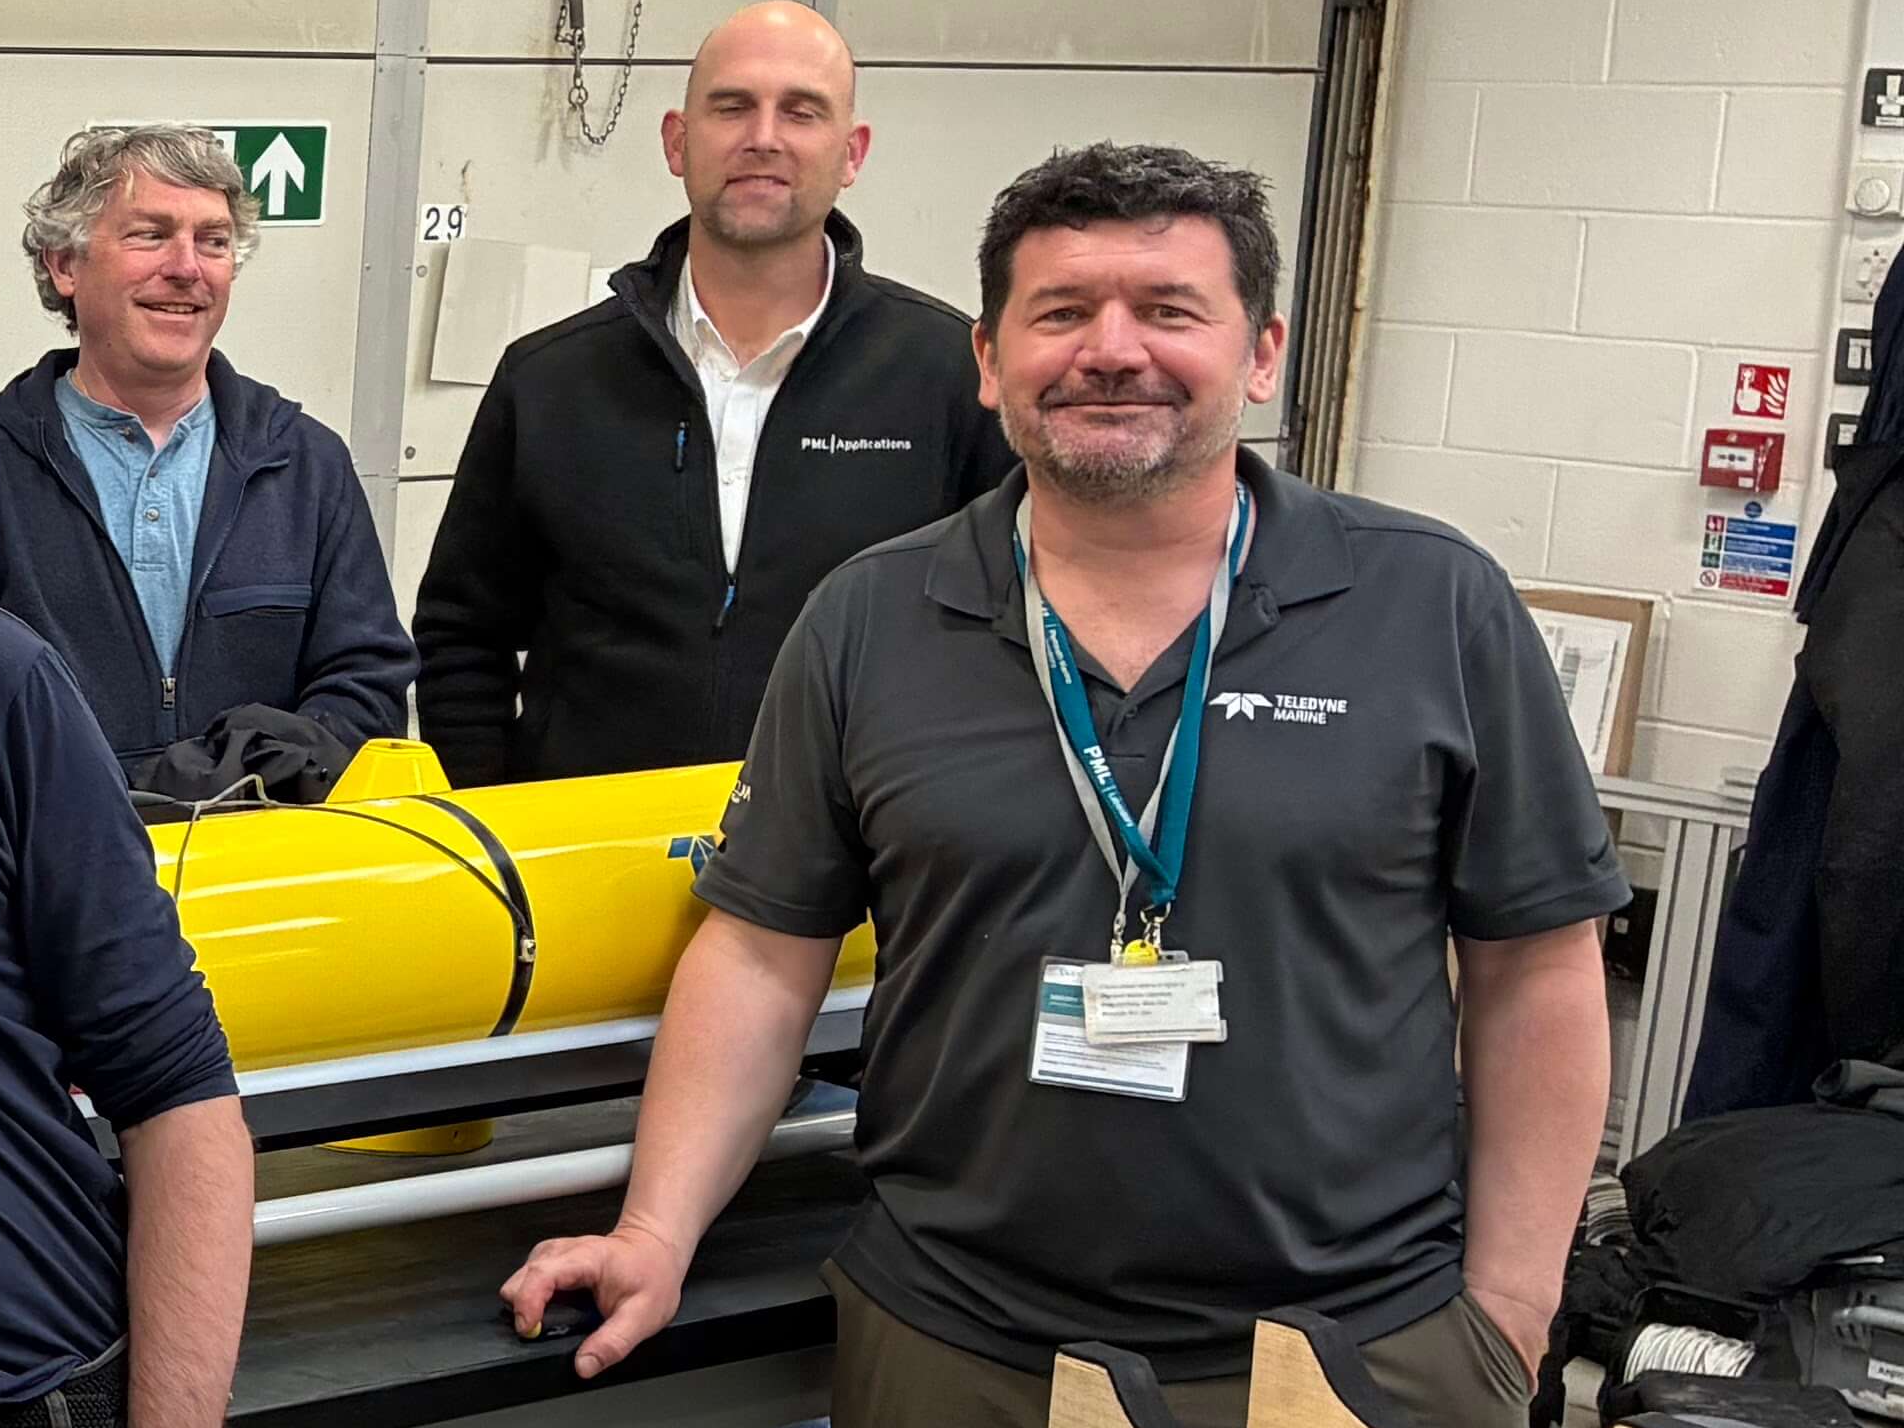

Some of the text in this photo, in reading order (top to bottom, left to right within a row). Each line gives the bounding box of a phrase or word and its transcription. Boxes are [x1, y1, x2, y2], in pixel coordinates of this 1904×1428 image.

[423, 206, 463, 241] 29
[801, 437, 912, 453] PML Applications
[1274, 694, 1348, 714] TELEDYNE
[1273, 708, 1327, 724] MARINE
[1083, 745, 1116, 787] PML
